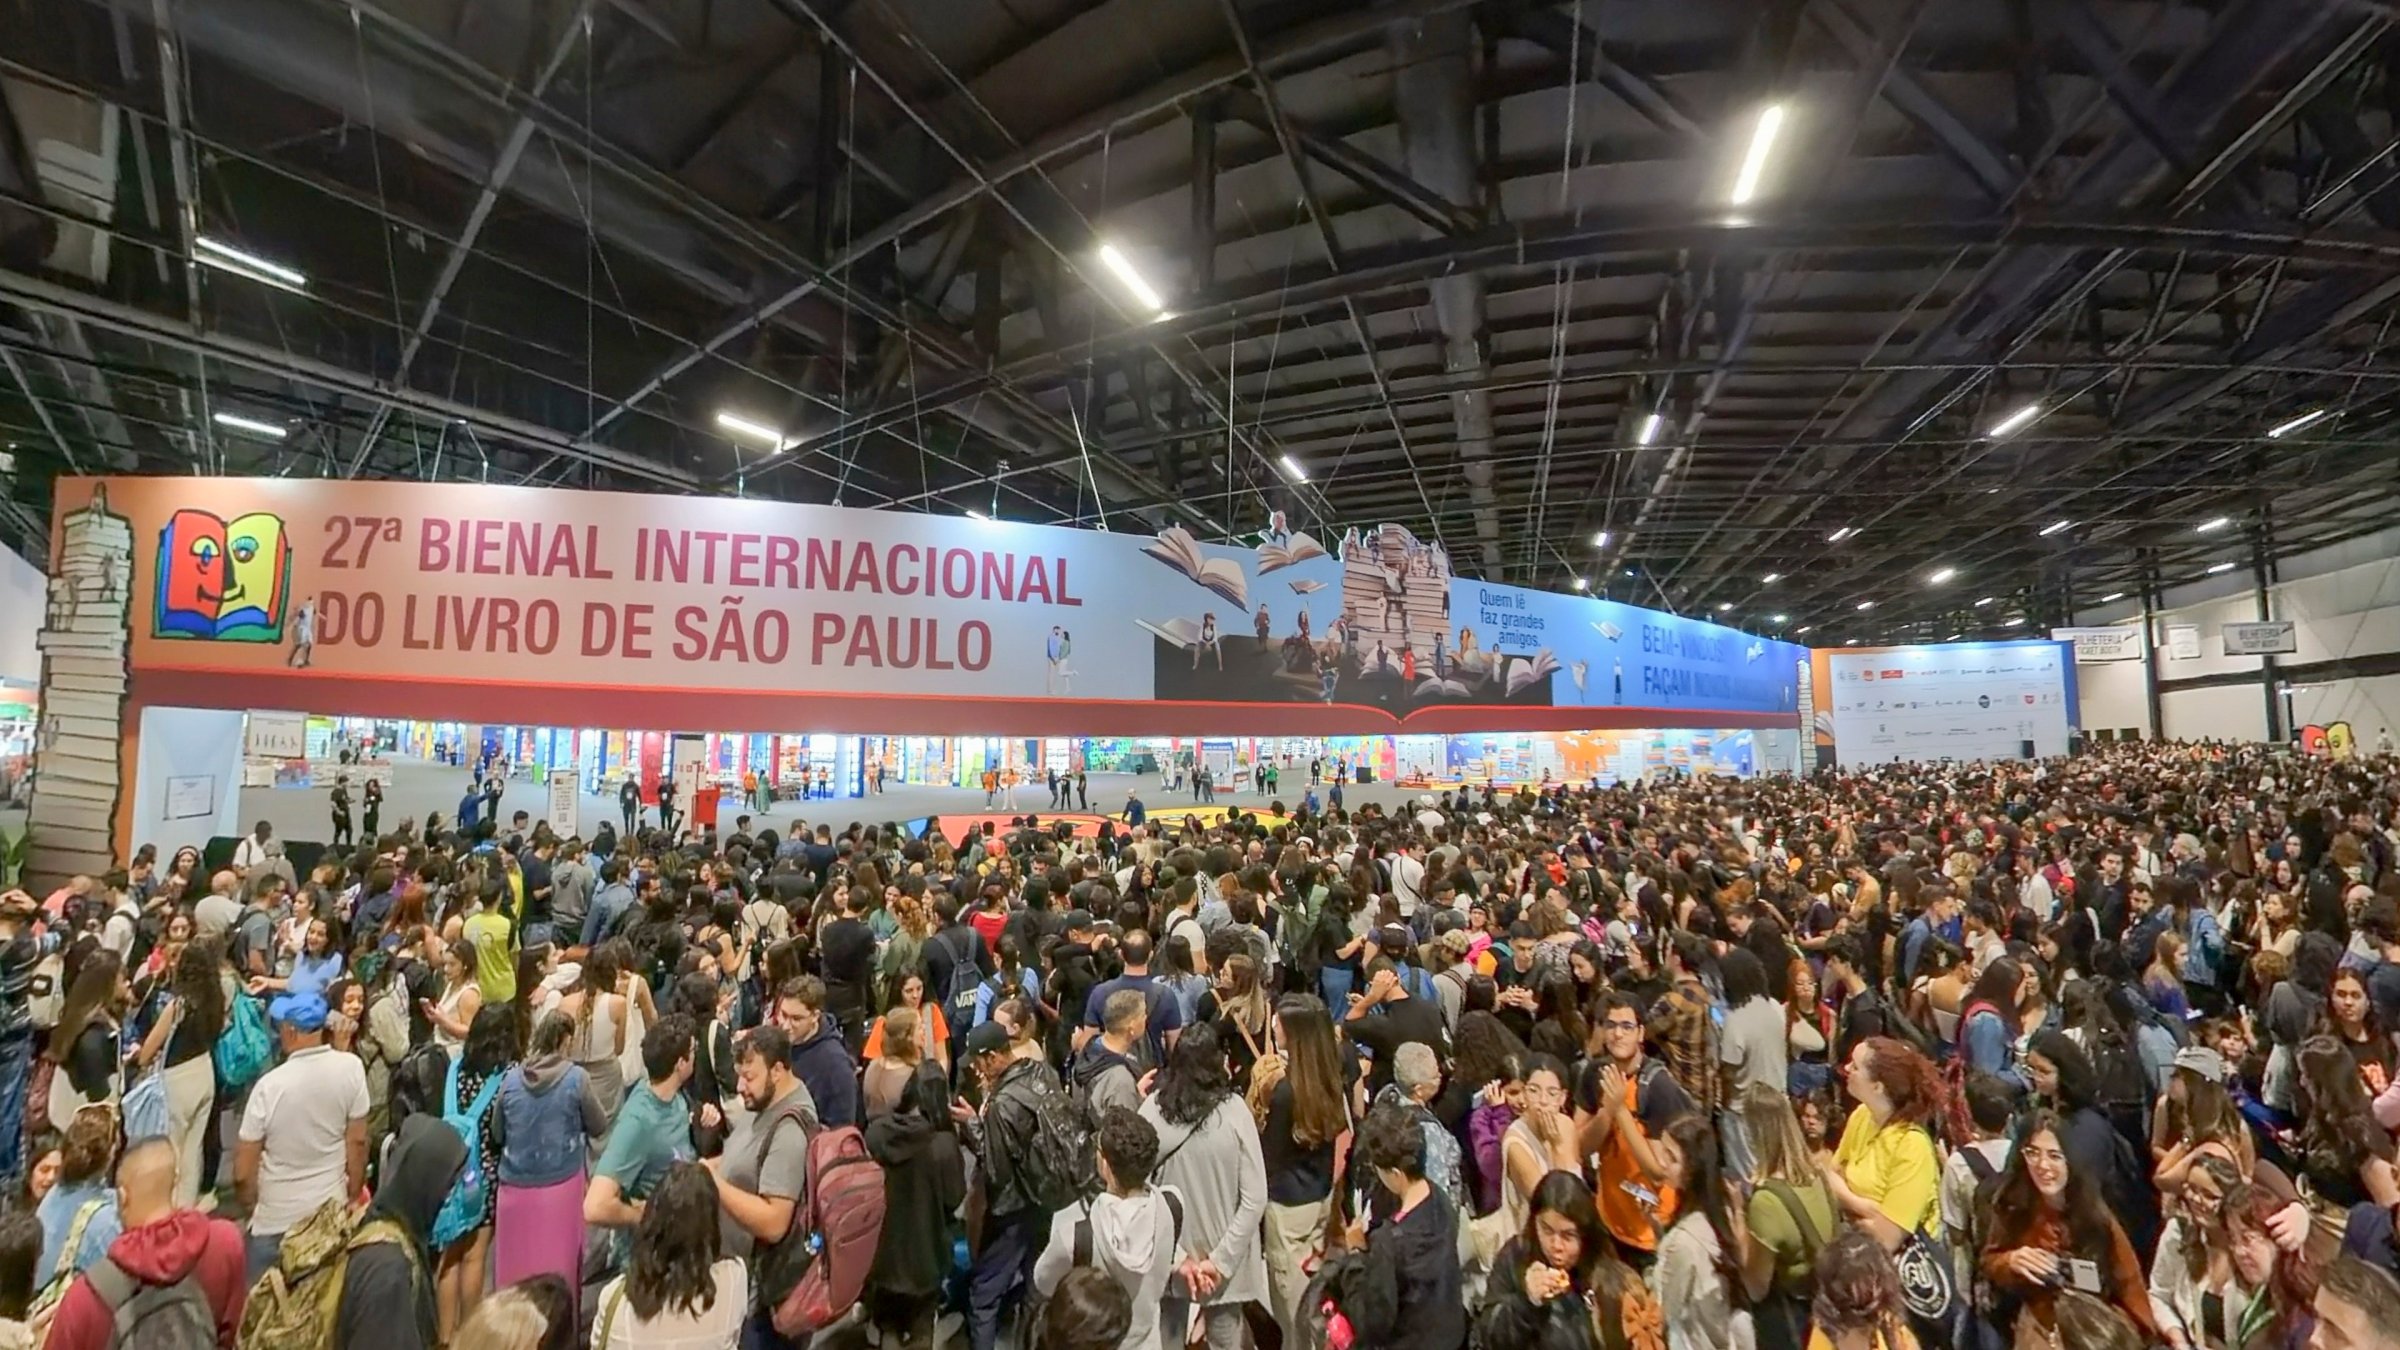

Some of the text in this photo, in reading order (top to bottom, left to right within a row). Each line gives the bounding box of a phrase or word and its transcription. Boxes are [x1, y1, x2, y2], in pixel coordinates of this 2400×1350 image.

[321, 515, 1083, 606] 27ª BIENAL INTERNACIONAL
[1480, 588, 1526, 610] Quem lê
[1480, 607, 1545, 630] faz grandes
[317, 591, 992, 671] DO LIVRO DE SÃO PAULO
[1499, 629, 1542, 649] amigos.
[955, 988, 977, 1008] VAN
